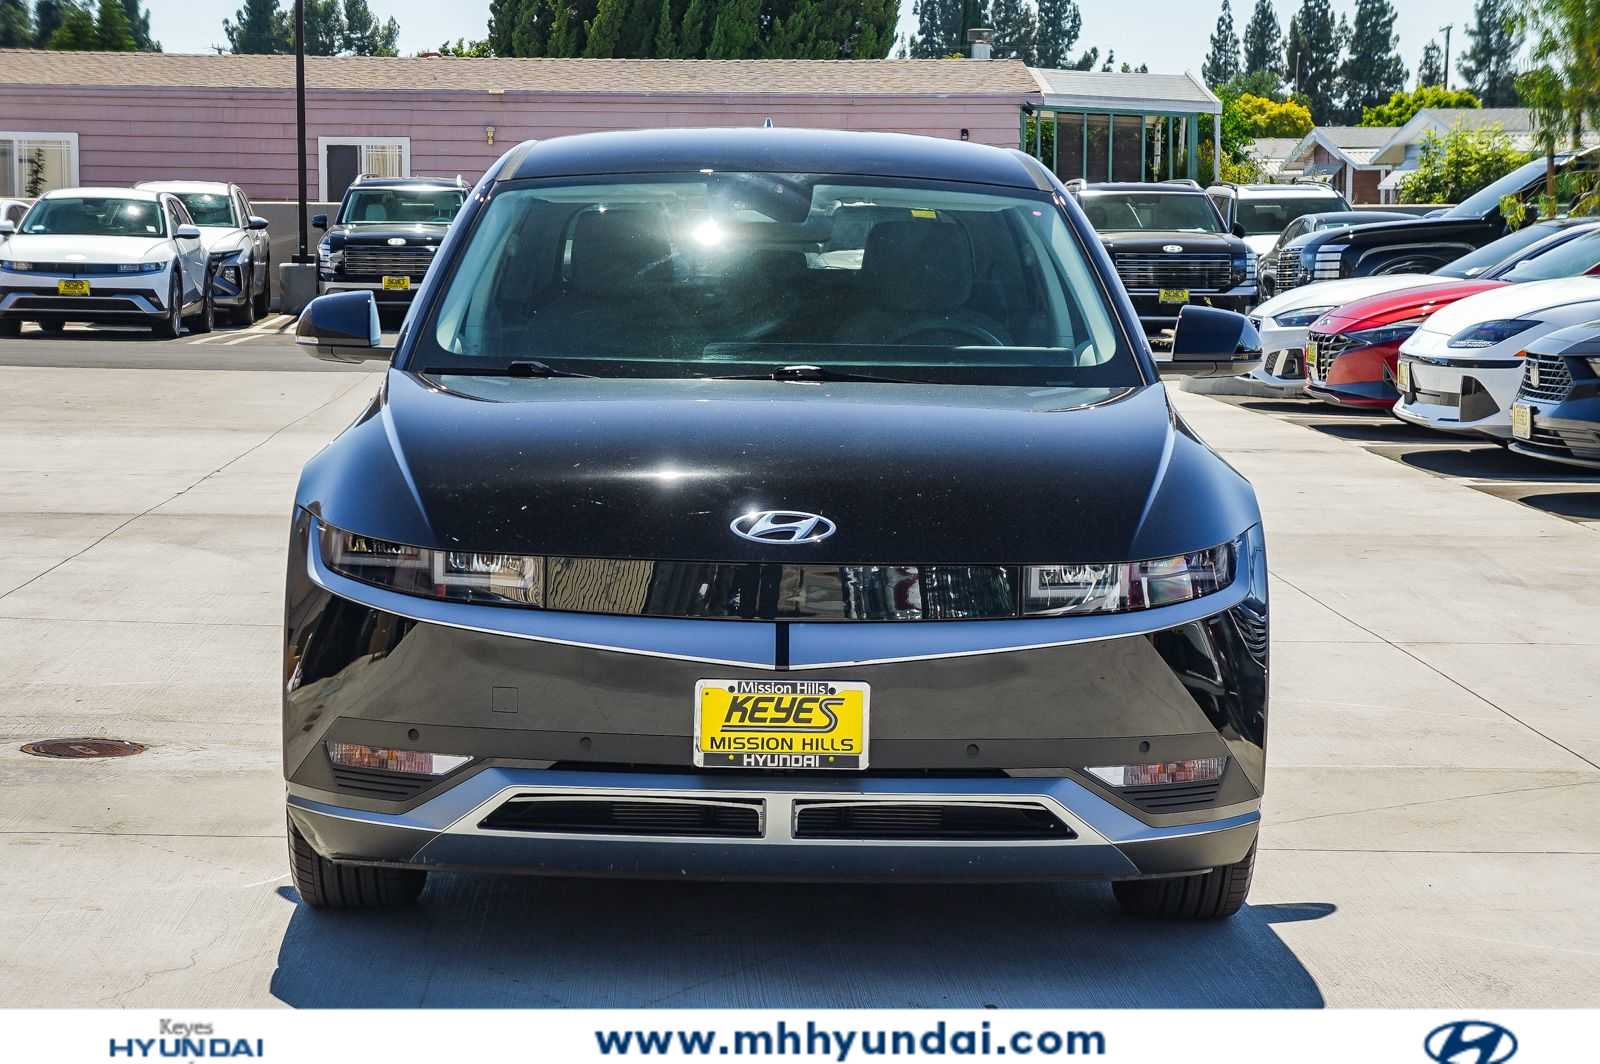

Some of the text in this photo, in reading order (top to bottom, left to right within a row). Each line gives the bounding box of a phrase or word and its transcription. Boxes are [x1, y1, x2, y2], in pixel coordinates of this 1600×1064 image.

[740, 682, 826, 694] Mission Hills
[722, 696, 845, 731] KEYES
[710, 737, 854, 751] MISSION HILLS
[743, 754, 820, 767] HYUNDAI
